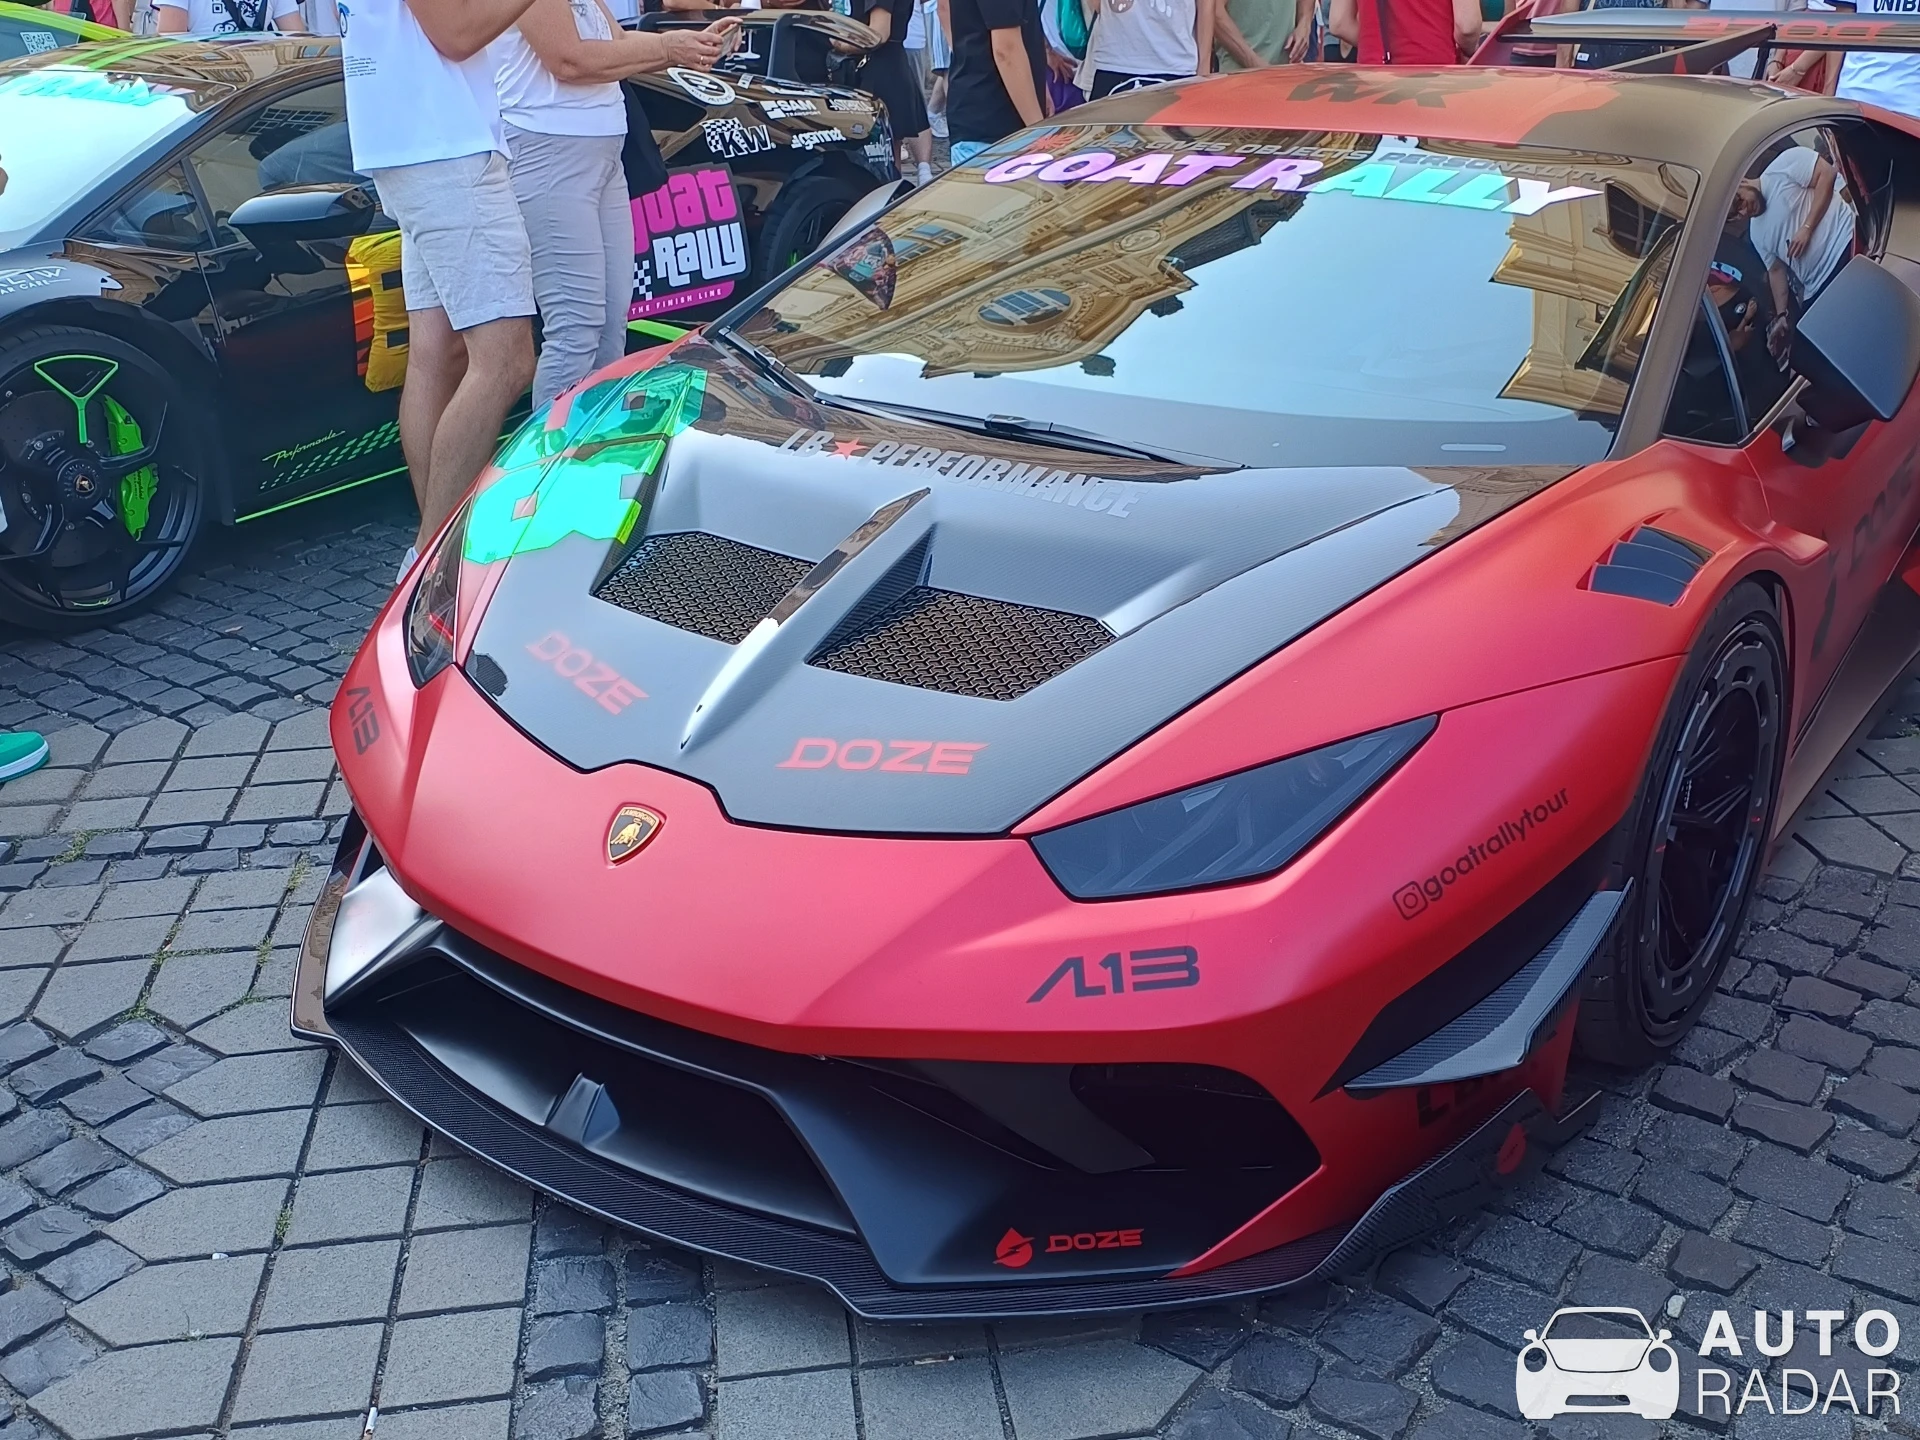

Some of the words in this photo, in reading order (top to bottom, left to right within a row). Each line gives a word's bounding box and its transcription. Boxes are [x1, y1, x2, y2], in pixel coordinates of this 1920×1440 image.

[1873, 0, 1920, 12] UNIB
[777, 100, 817, 111] SAM
[1145, 140, 1231, 152] GIVES
[1235, 144, 1374, 161] OBJECTS
[1378, 152, 1616, 184] PERSONALITY
[984, 153, 1246, 186] GOAT
[1230, 158, 1604, 216] RALLY
[632, 306, 650, 315] THE
[656, 295, 693, 309] FINISH
[698, 288, 722, 300] LINE
[775, 429, 834, 456] LB
[857, 440, 1152, 519] PERFORMANCE
[526, 631, 650, 716] DOZE
[776, 738, 990, 775] DOZE
[1424, 788, 1569, 901] goatrallytour
[1045, 1228, 1145, 1253] DOZE
